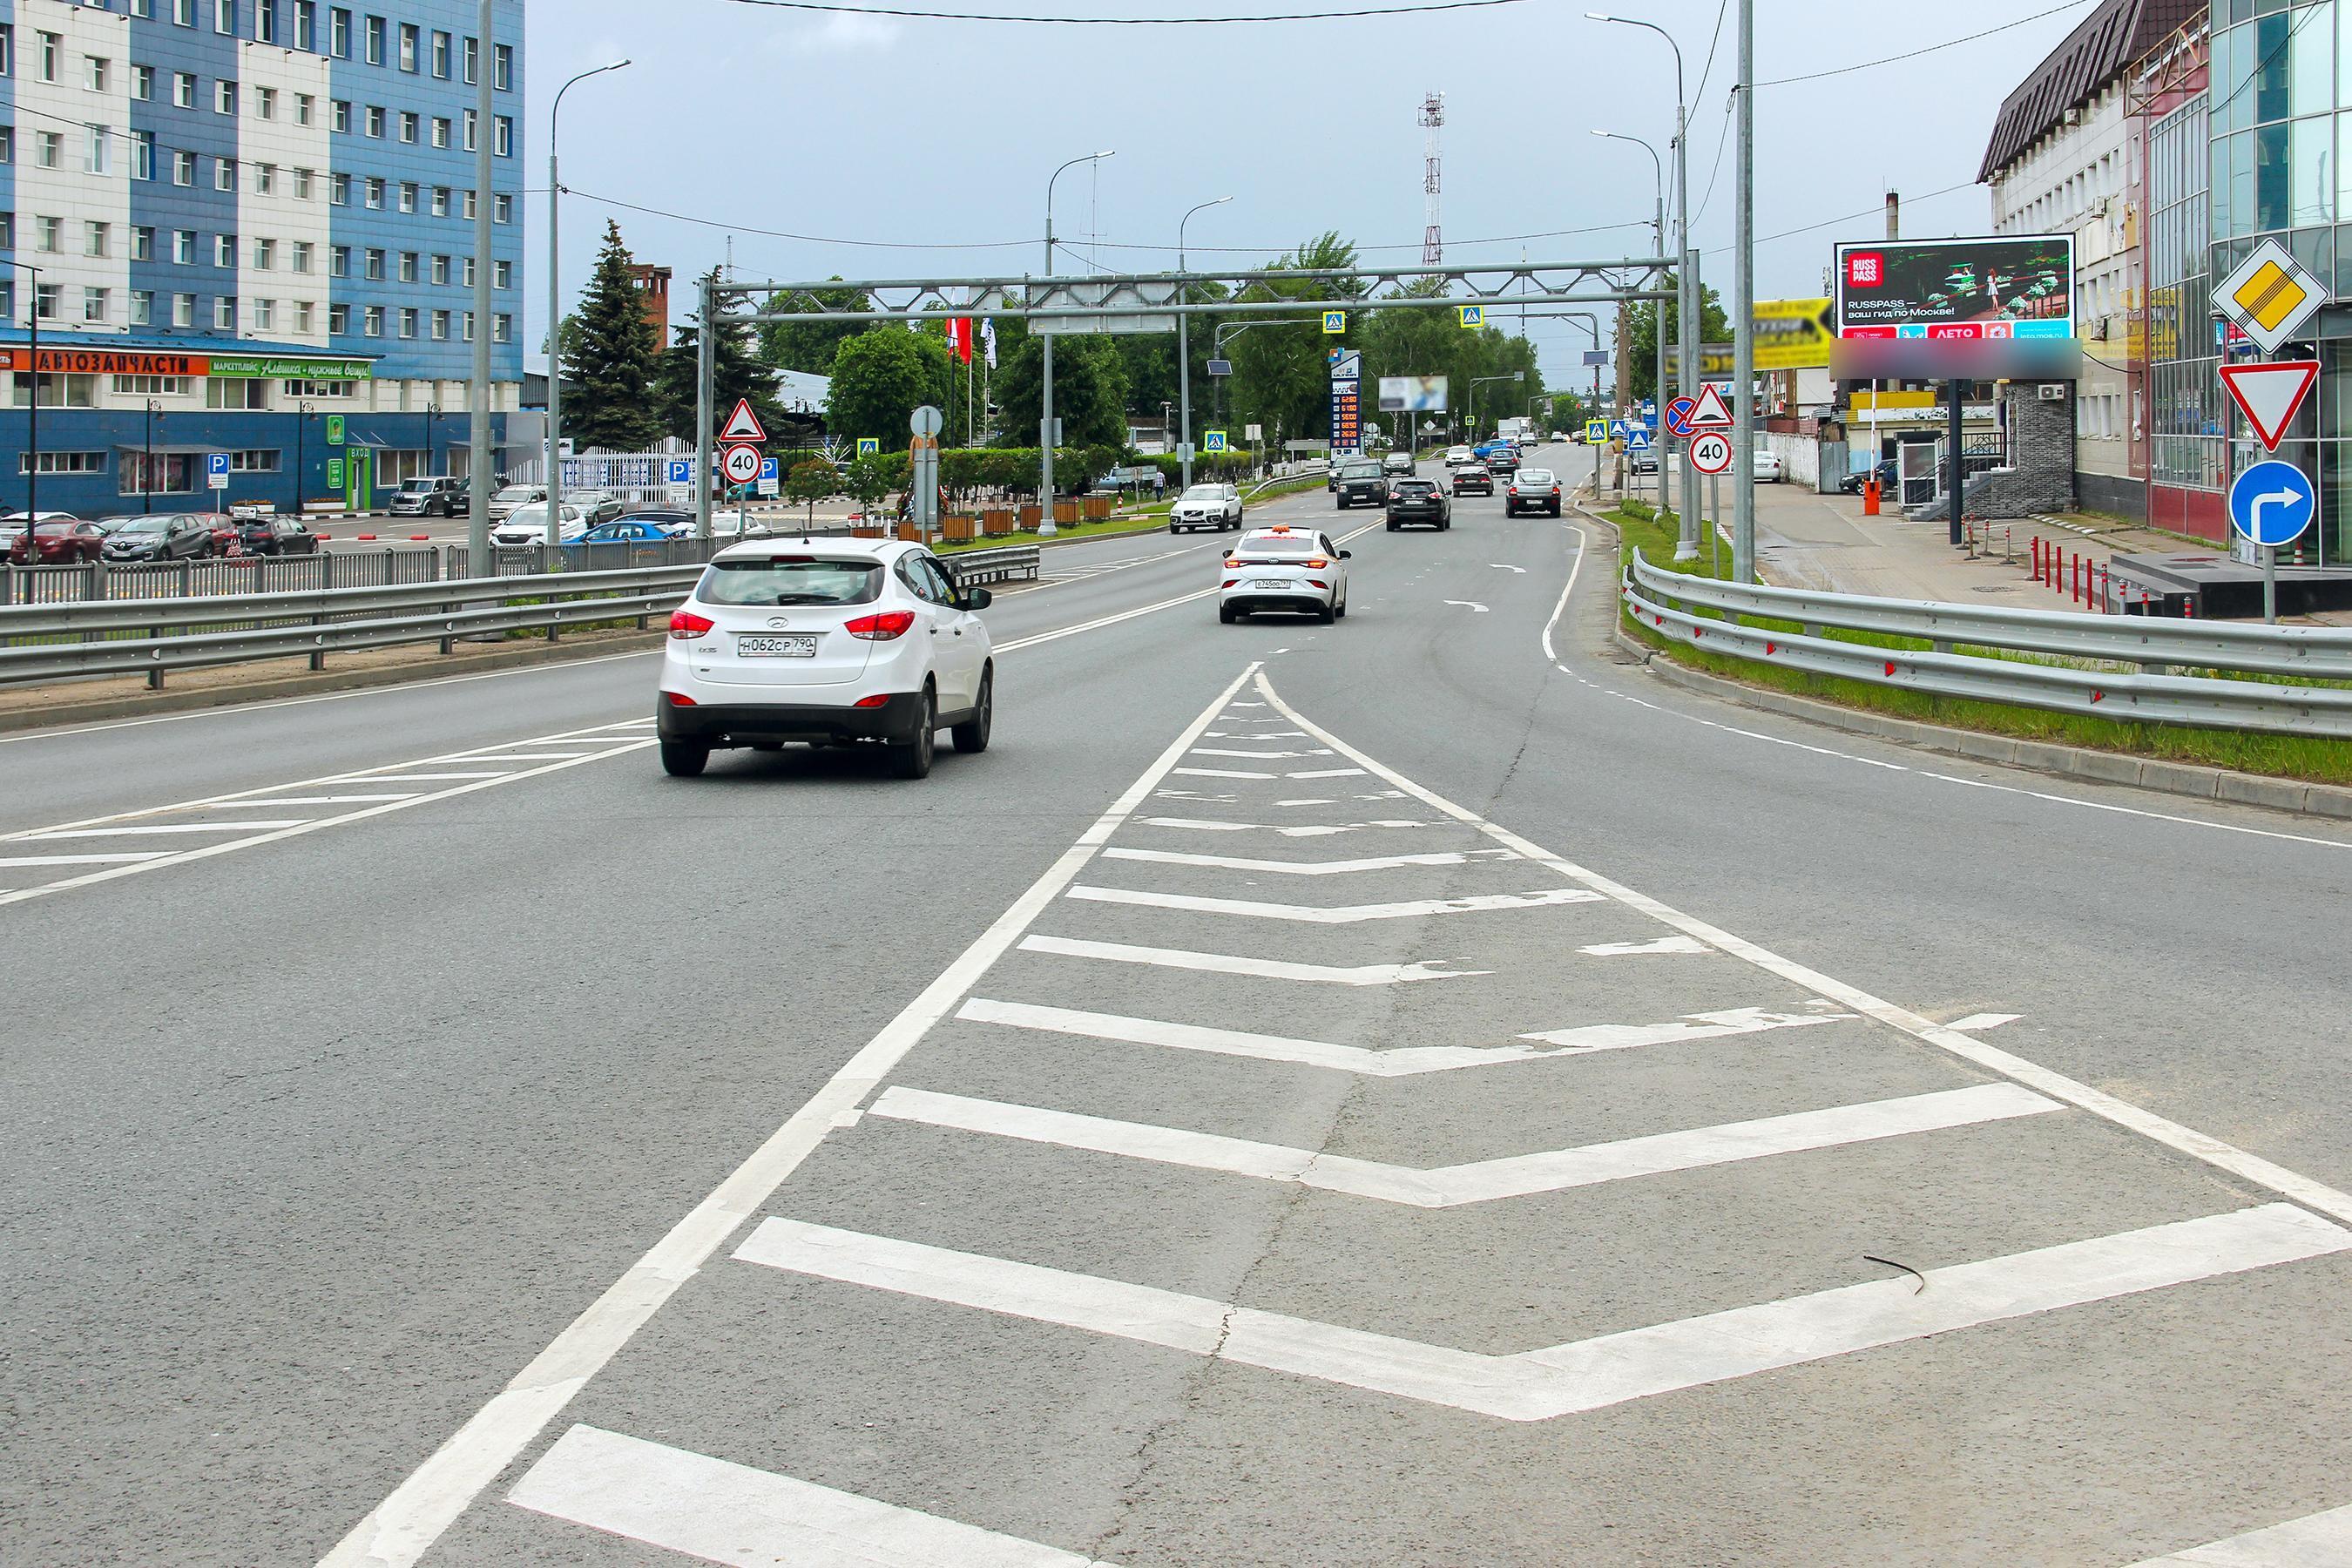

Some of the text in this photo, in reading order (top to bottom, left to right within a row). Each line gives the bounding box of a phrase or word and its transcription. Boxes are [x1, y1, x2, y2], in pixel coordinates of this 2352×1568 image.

[1852, 259, 1876, 270] RUSS
[1852, 270, 1876, 282] PASS
[1848, 300, 1905, 309] RUSSPASS
[1848, 310, 1871, 319] ваш
[1874, 310, 1893, 319] гид
[1909, 308, 1955, 317] Москве!
[1936, 328, 1974, 339] ЛЕТО
[38, 353, 189, 373] АВТОЗАПЧАСТИ
[213, 362, 258, 373] МАРКЕТПЛЕЙС
[260, 359, 301, 375] Алёшка
[308, 365, 342, 378] нужные
[344, 362, 370, 379] вещи!
[351, 448, 368, 458] ВХОД
[1699, 443, 1723, 460] 40
[731, 455, 754, 470] 40
[743, 639, 812, 652] Н062СР 790
